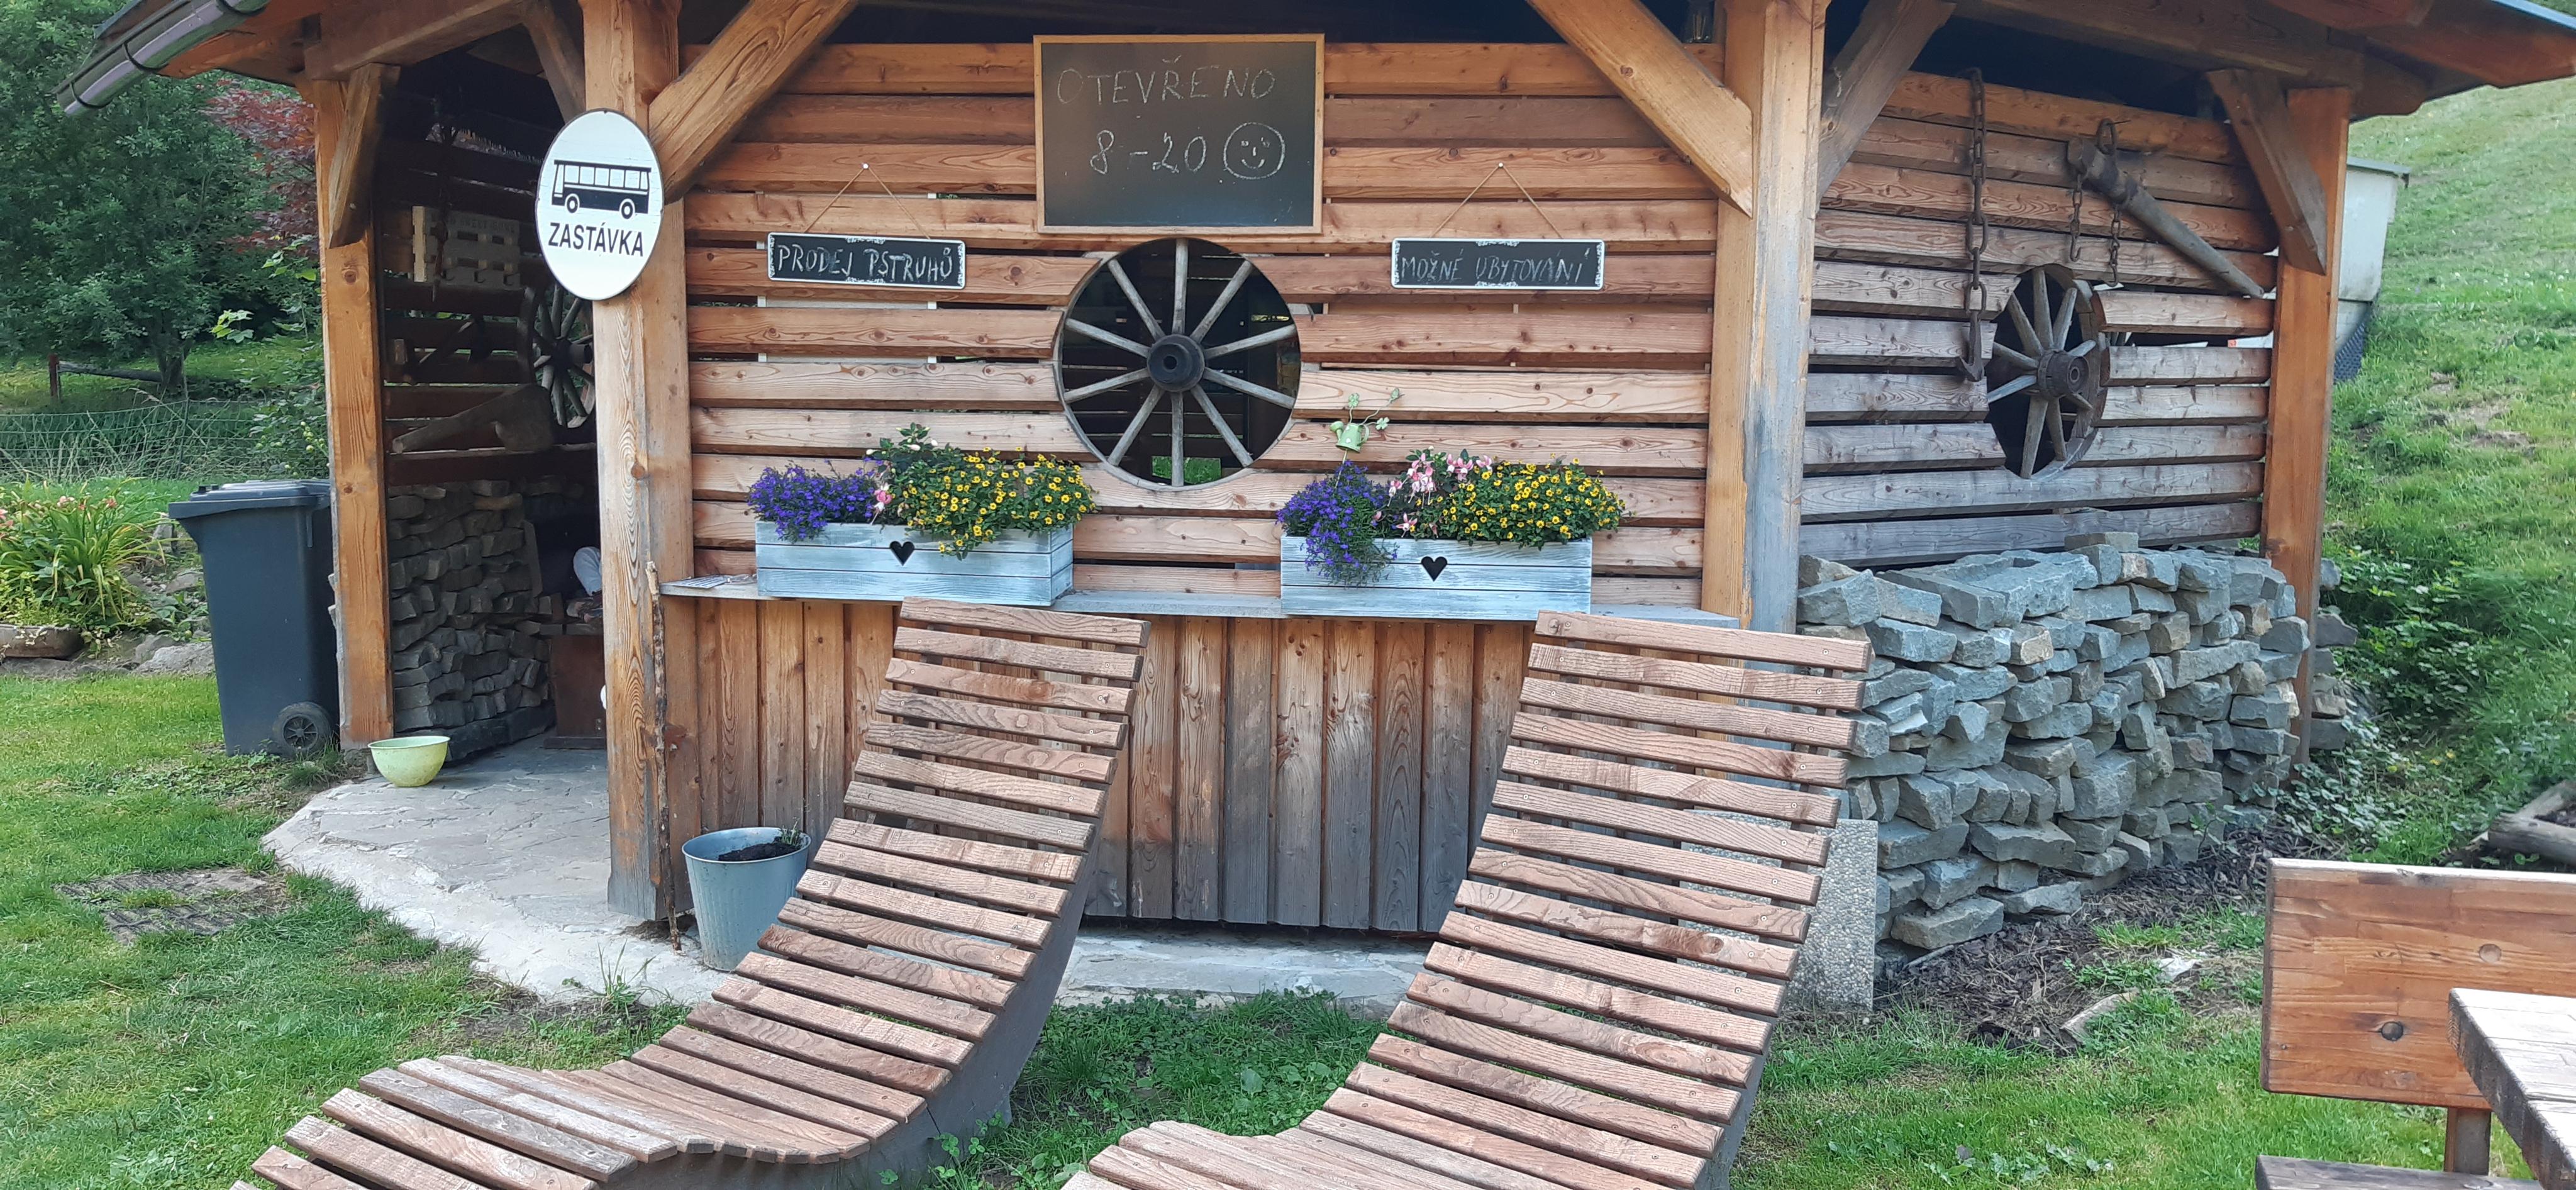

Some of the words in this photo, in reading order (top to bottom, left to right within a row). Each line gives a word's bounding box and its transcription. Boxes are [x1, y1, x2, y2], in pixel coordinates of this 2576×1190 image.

[1057, 55, 1276, 104] OTEVŘENO
[548, 222, 643, 257] ZASTÁVKA
[777, 244, 853, 277] PRODEJ
[862, 247, 953, 282] PSTRUHŮ
[1401, 248, 1464, 284] MOŽNÉ
[1475, 247, 1591, 284] UBYTOVÁNÍ
